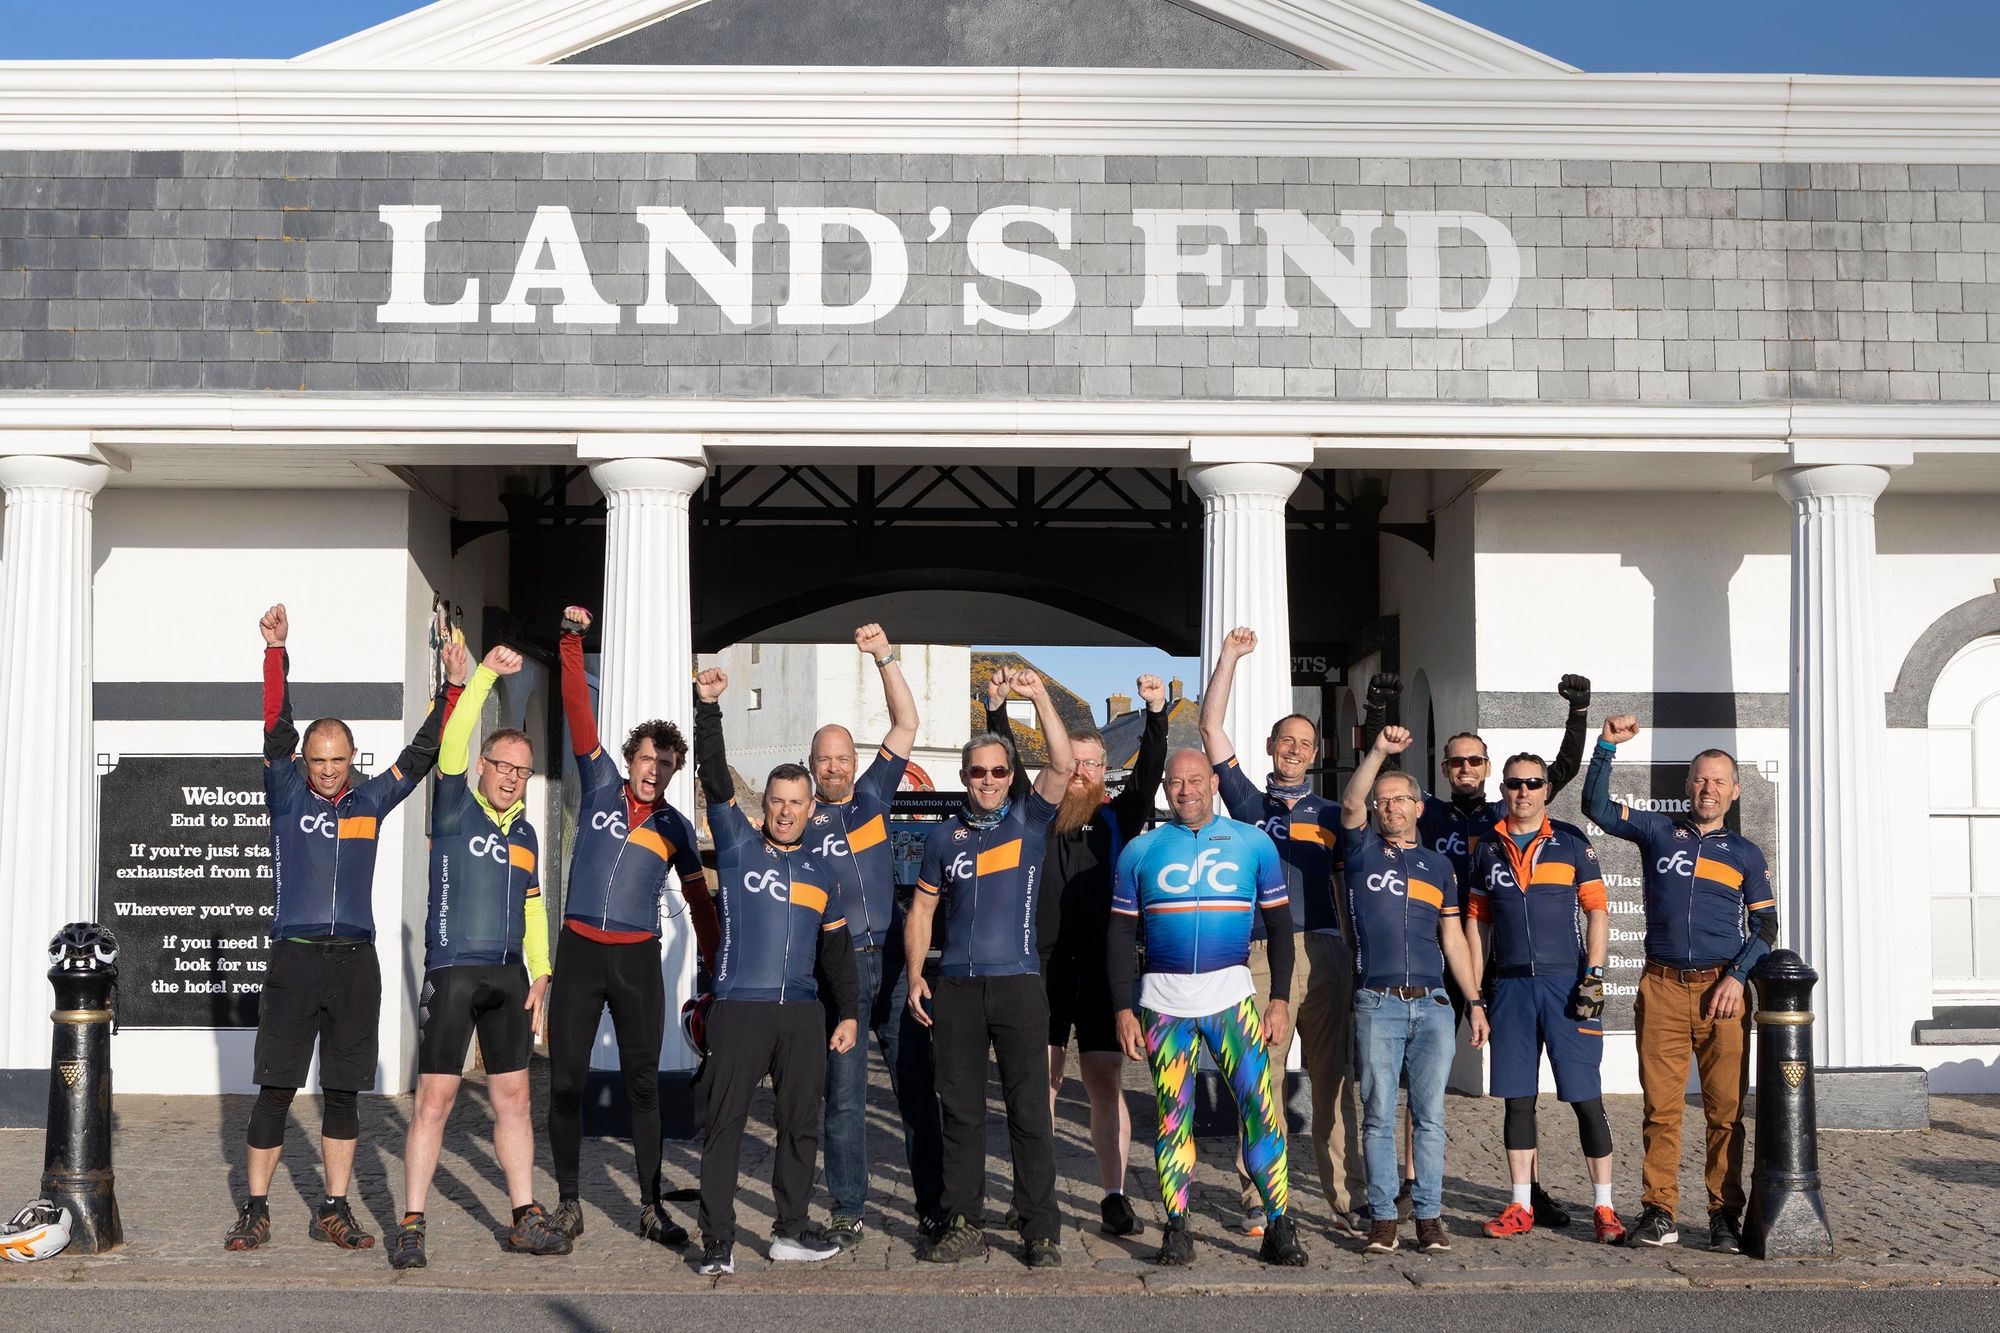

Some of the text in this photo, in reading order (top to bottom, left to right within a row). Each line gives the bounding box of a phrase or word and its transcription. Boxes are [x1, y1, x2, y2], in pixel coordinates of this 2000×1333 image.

[376, 204, 1522, 331] LAND'S END
[1609, 793, 1692, 813] lcome
[171, 813, 205, 827] End
[210, 814, 229, 827] to
[300, 812, 335, 838] cfc
[591, 810, 627, 839] cfc
[1586, 822, 1604, 836] to
[129, 843, 271, 861] If you're just sta
[469, 833, 507, 864] cfc
[812, 833, 849, 857] fc
[116, 865, 205, 879] exhausted
[209, 865, 251, 879] from
[1157, 848, 1240, 894] cfc
[1656, 850, 1693, 877] cfc
[743, 869, 788, 902] cfc
[1366, 869, 1404, 896] cfc
[1601, 874, 1641, 887] Wlas
[114, 902, 196, 916] Wherever
[200, 903, 254, 919] you've
[439, 855, 450, 947] Cyclists Fighting Cancer
[1023, 865, 1036, 955] Cyclists Fighting Cancer
[162, 935, 178, 949] if
[180, 938, 212, 952] you
[217, 936, 258, 949] need
[1609, 928, 1647, 941] Benv
[718, 952, 728, 981] Cyclists
[723, 917, 731, 952] Fighting
[174, 957, 267, 971] look for us
[151, 980, 179, 993] the
[184, 980, 227, 993] hotel
